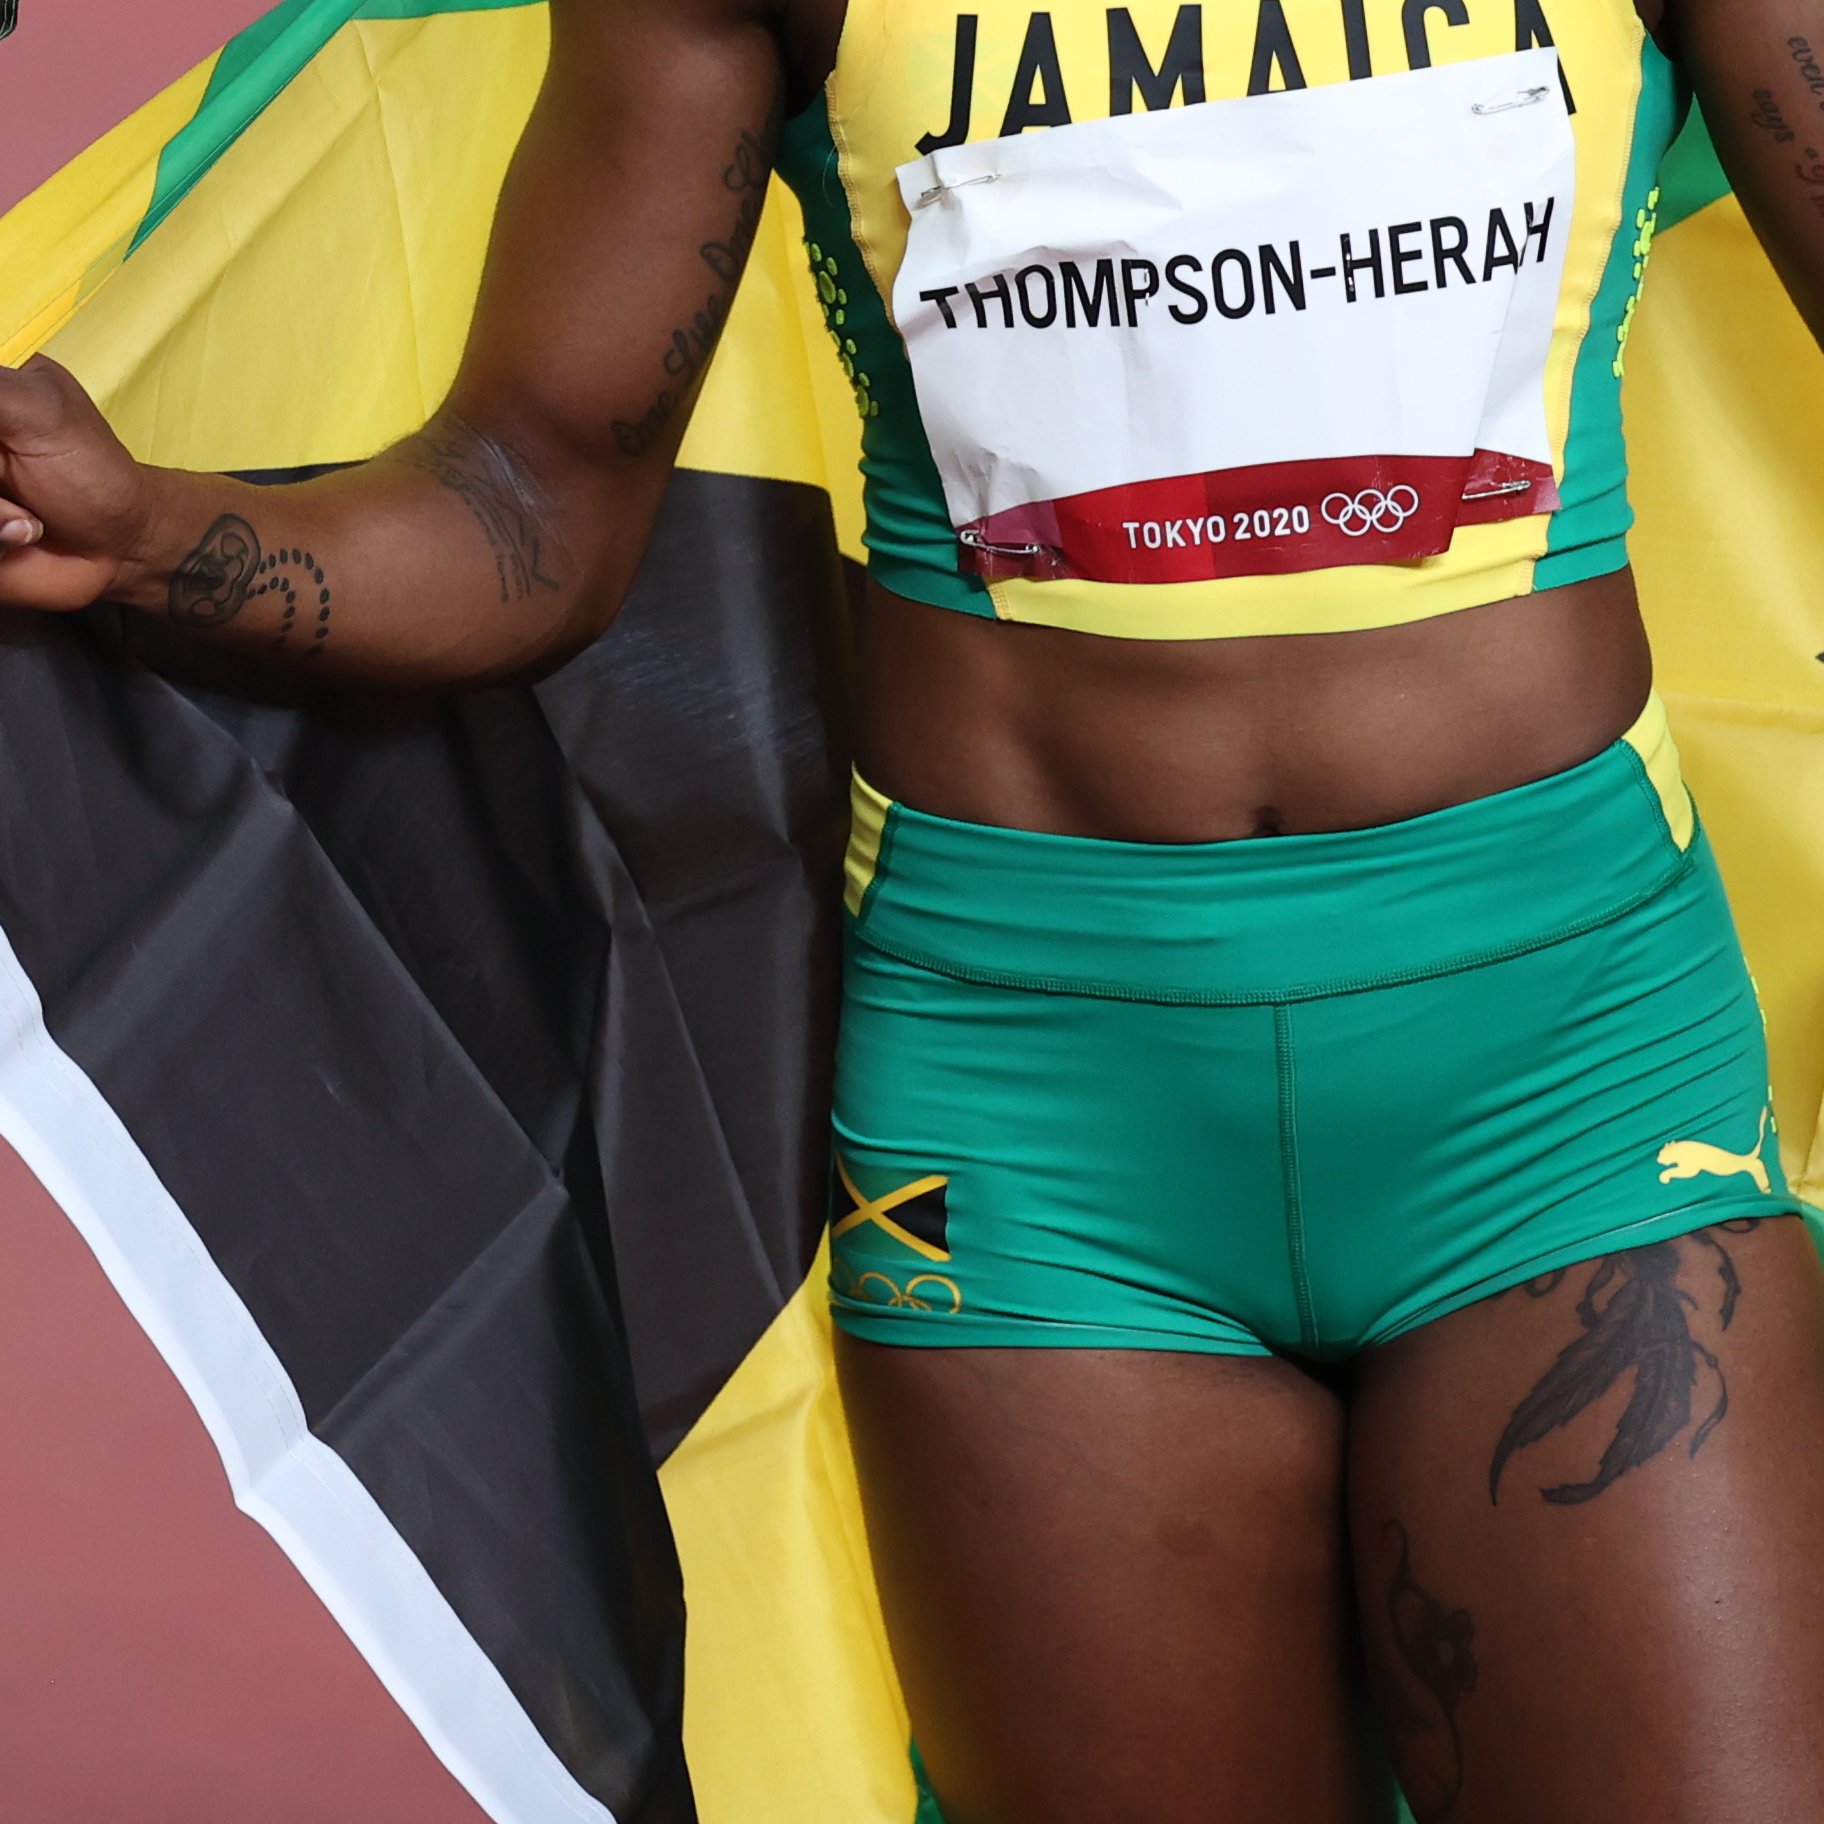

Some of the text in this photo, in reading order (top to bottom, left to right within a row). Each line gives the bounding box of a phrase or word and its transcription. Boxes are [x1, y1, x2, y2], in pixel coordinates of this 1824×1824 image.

[919, 197, 1555, 329] THOMPSON-HERAH
[1122, 505, 1310, 550] TOKYO 2020
